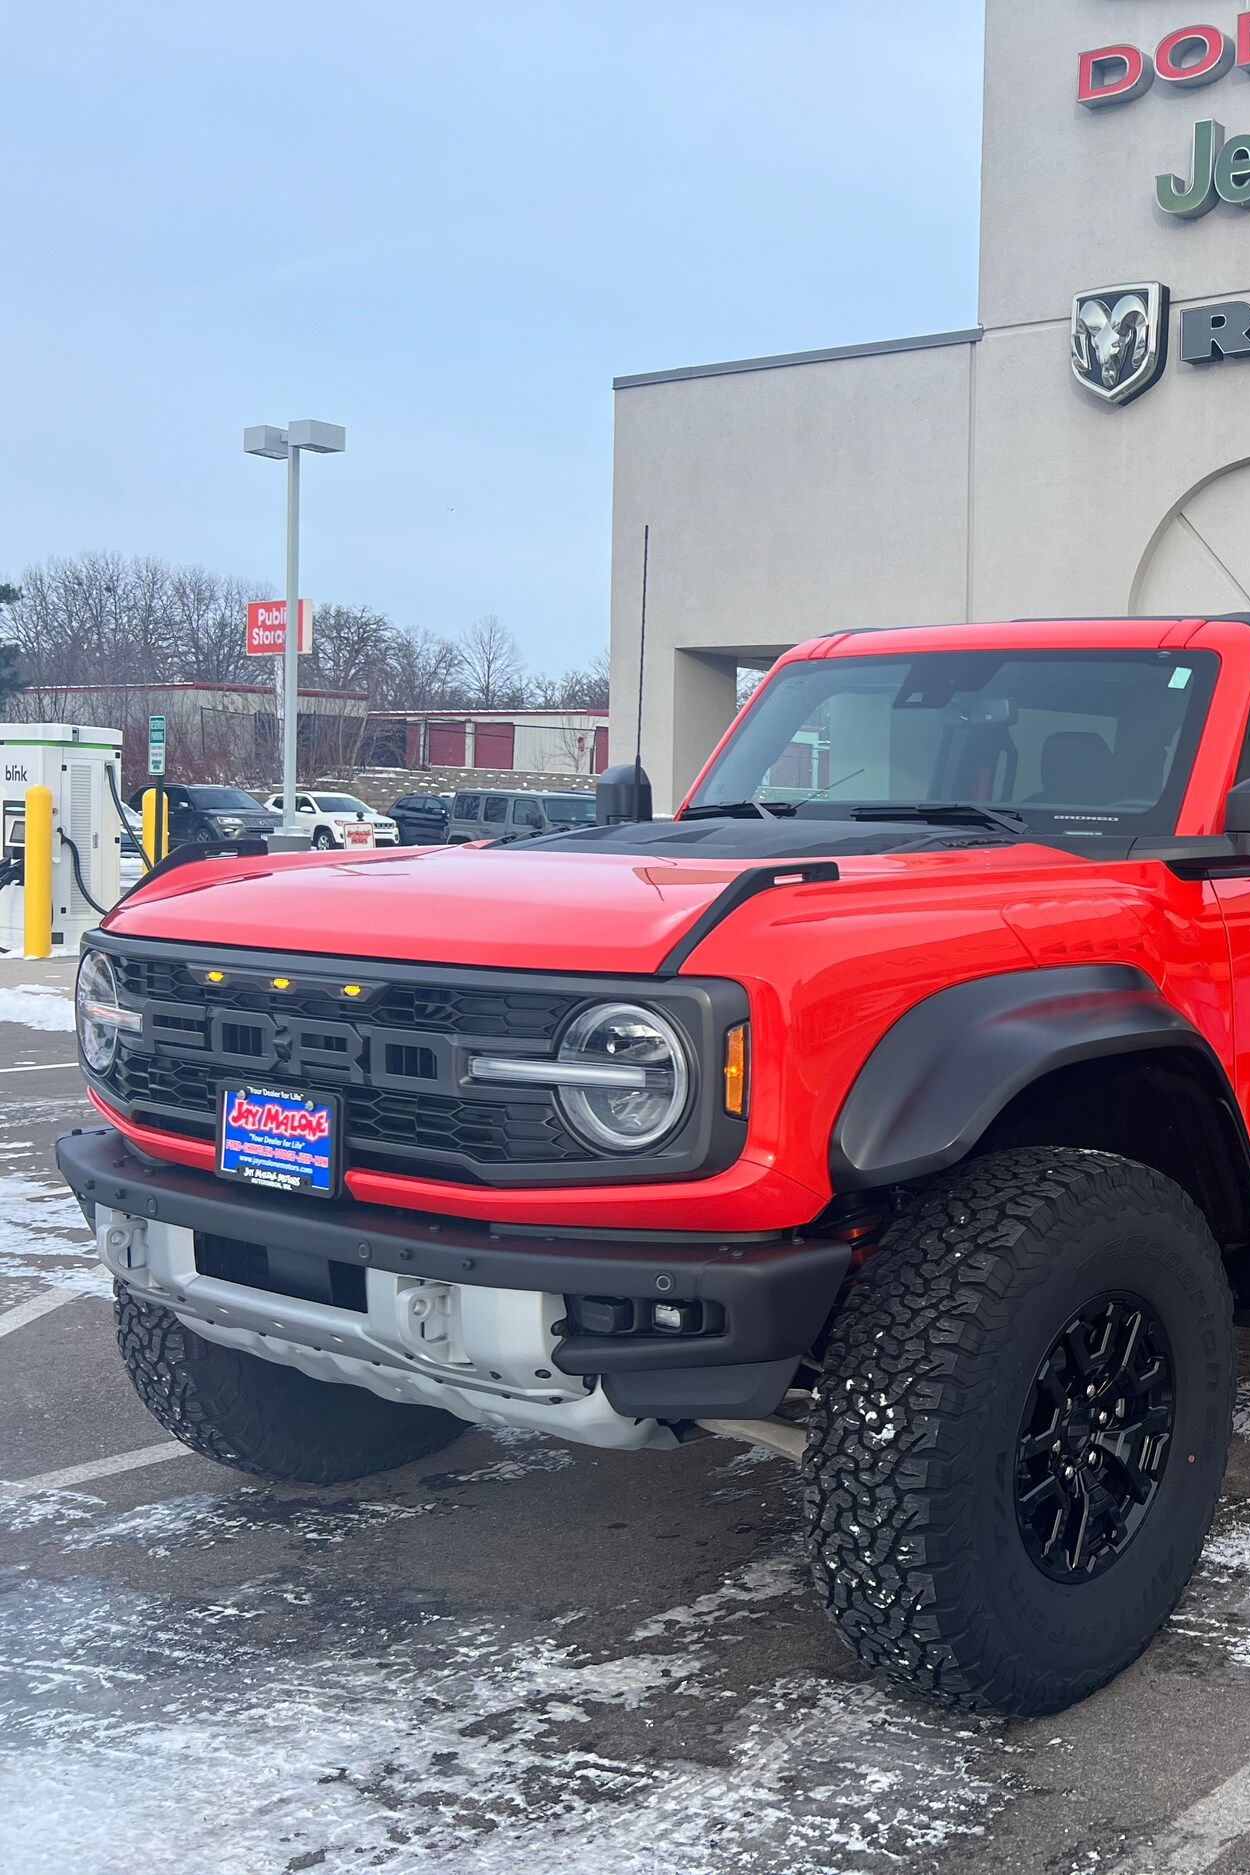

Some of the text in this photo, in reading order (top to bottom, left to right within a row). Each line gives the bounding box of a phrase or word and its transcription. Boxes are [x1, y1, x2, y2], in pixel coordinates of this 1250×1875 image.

[5, 764, 27, 782] blink
[143, 999, 460, 1098] FORD
[263, 1088, 281, 1098] Dealer
[281, 1091, 290, 1099] for
[228, 1098, 330, 1142] JAY MALONE
[264, 1136, 283, 1147] Dealer
[283, 1138, 292, 1147] for
